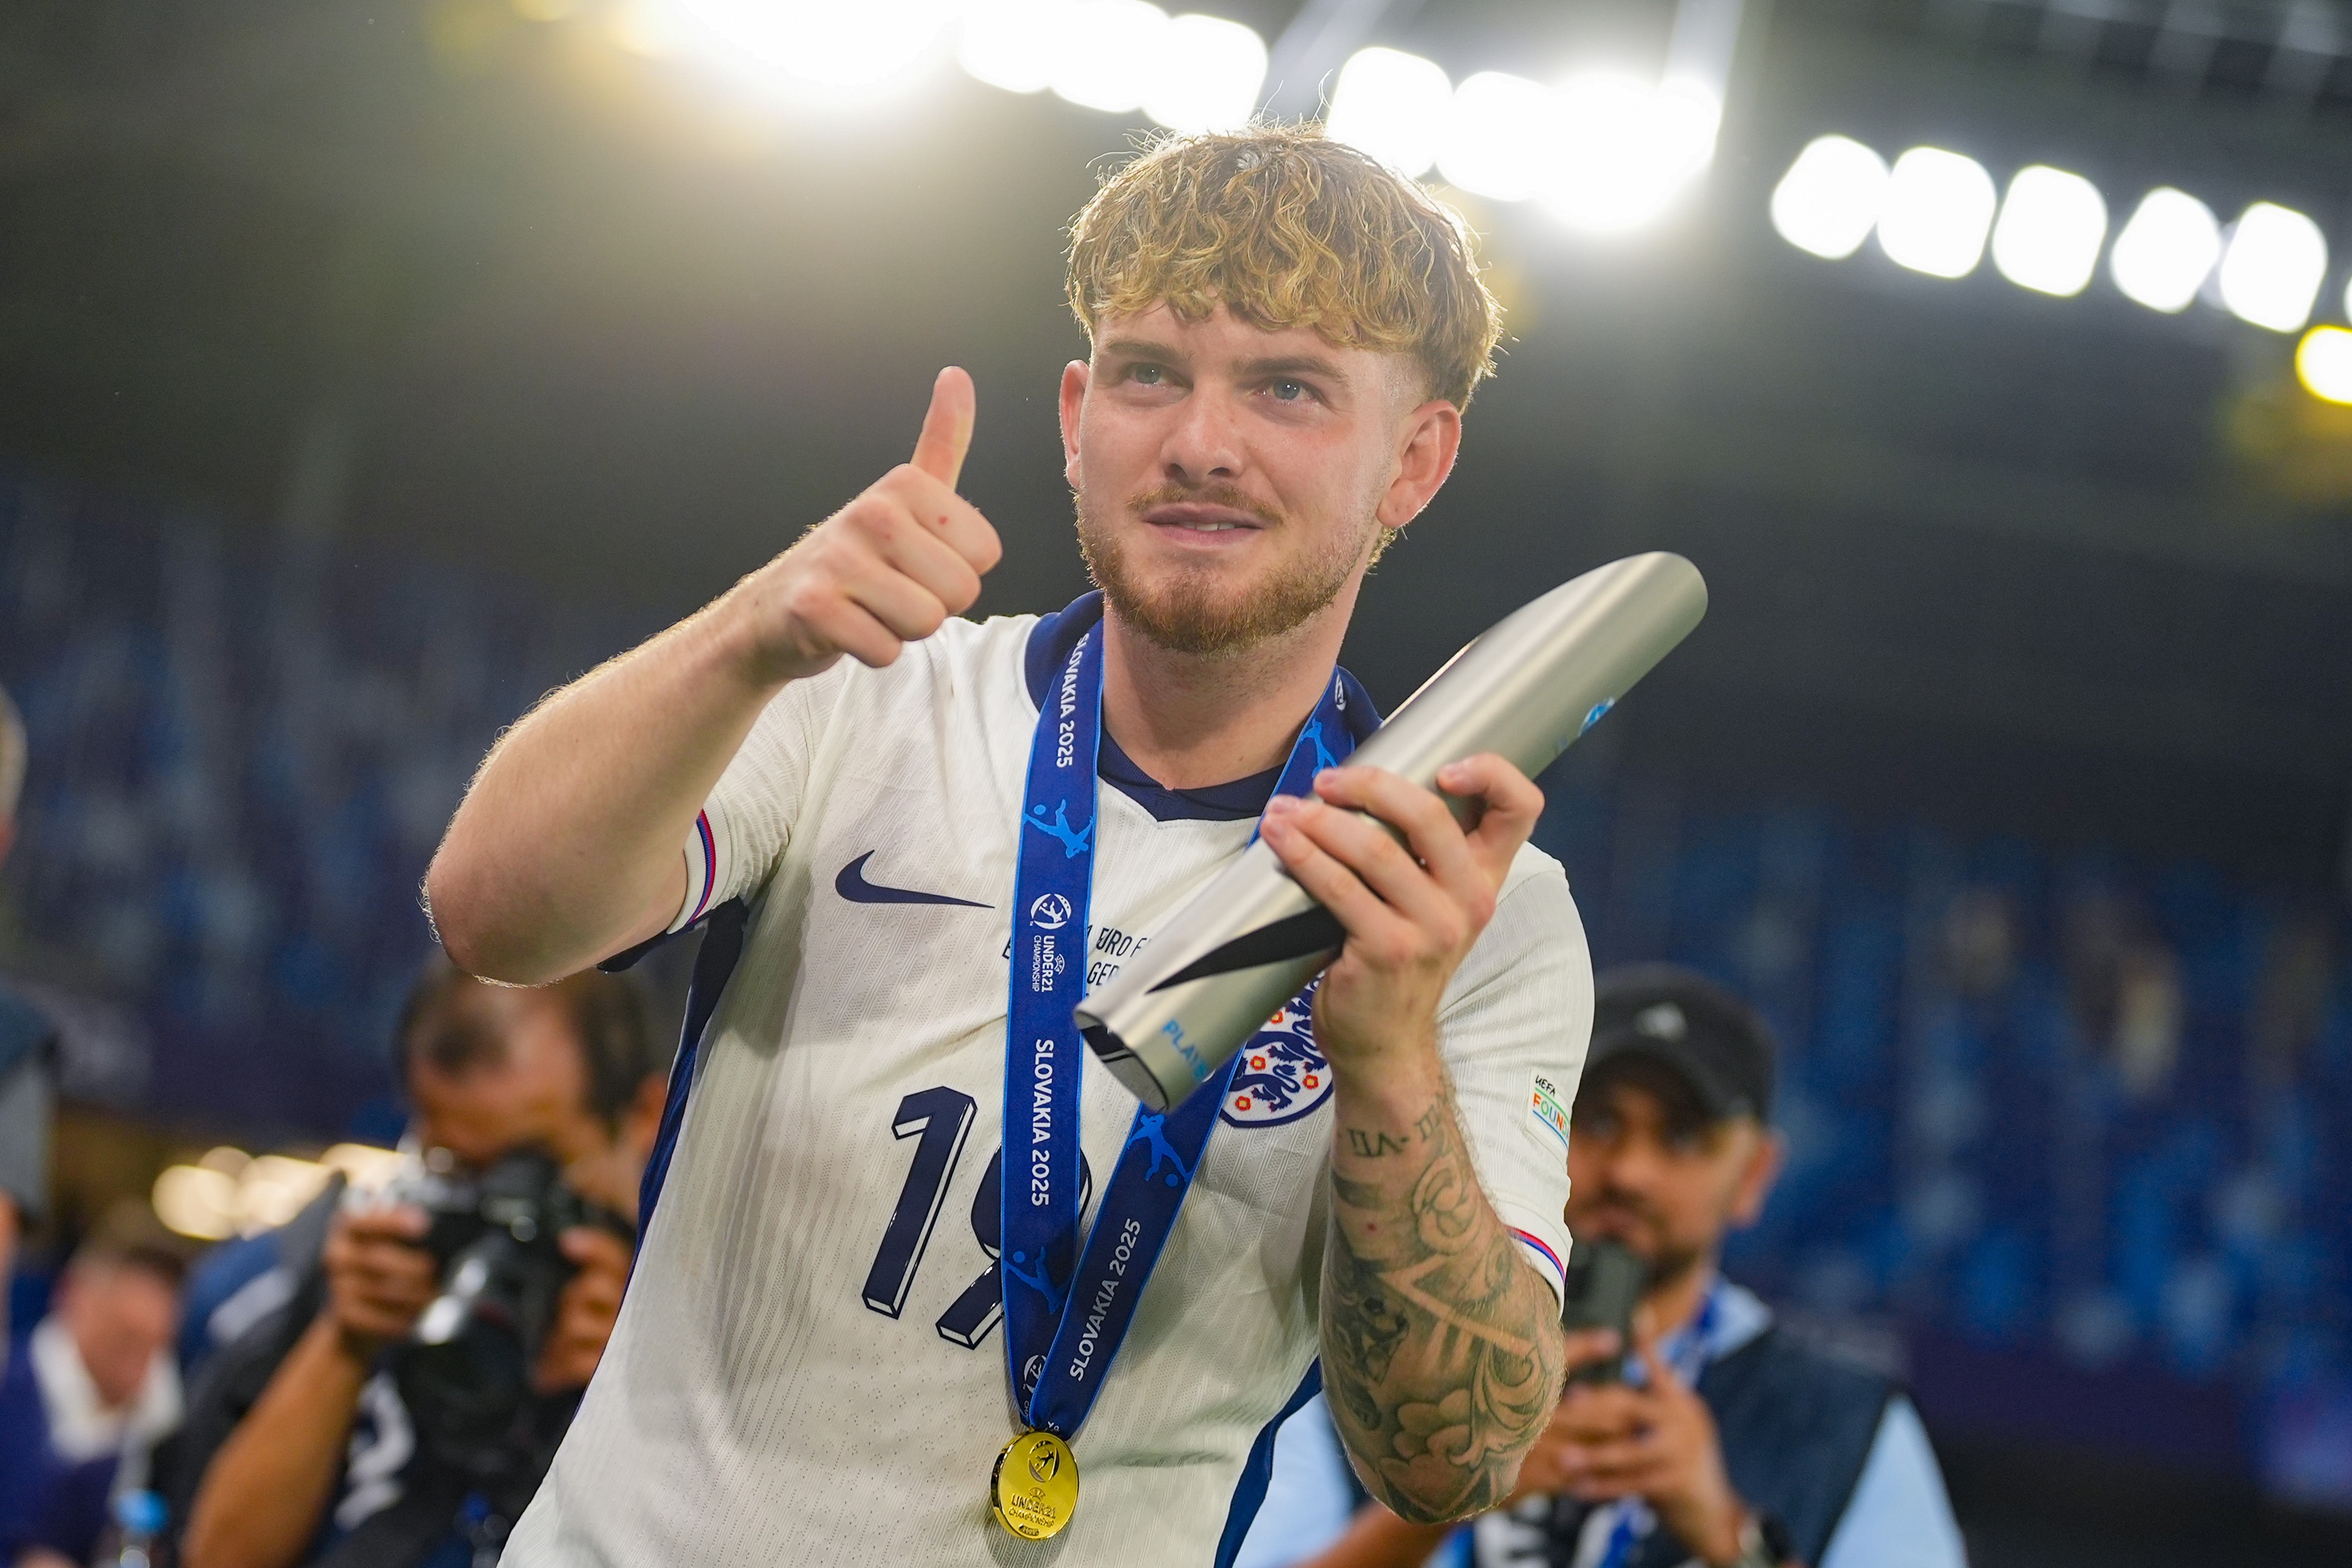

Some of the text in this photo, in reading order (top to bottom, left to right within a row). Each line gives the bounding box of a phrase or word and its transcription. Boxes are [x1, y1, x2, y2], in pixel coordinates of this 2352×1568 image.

[1056, 633, 1090, 768] SLOVAKIA 2025
[1032, 935, 1042, 992] CHAMPIONSHIP
[1042, 935, 1055, 992] UNDER21
[1535, 1075, 1556, 1096] UEFA
[1031, 1039, 1054, 1207] SLOVAKIA 2025
[1070, 1218, 1141, 1381] SLOVAKIA 2025
[1009, 1507, 1055, 1528] CHAMPIONSHIP
[1011, 1493, 1056, 1519] UNDER21
